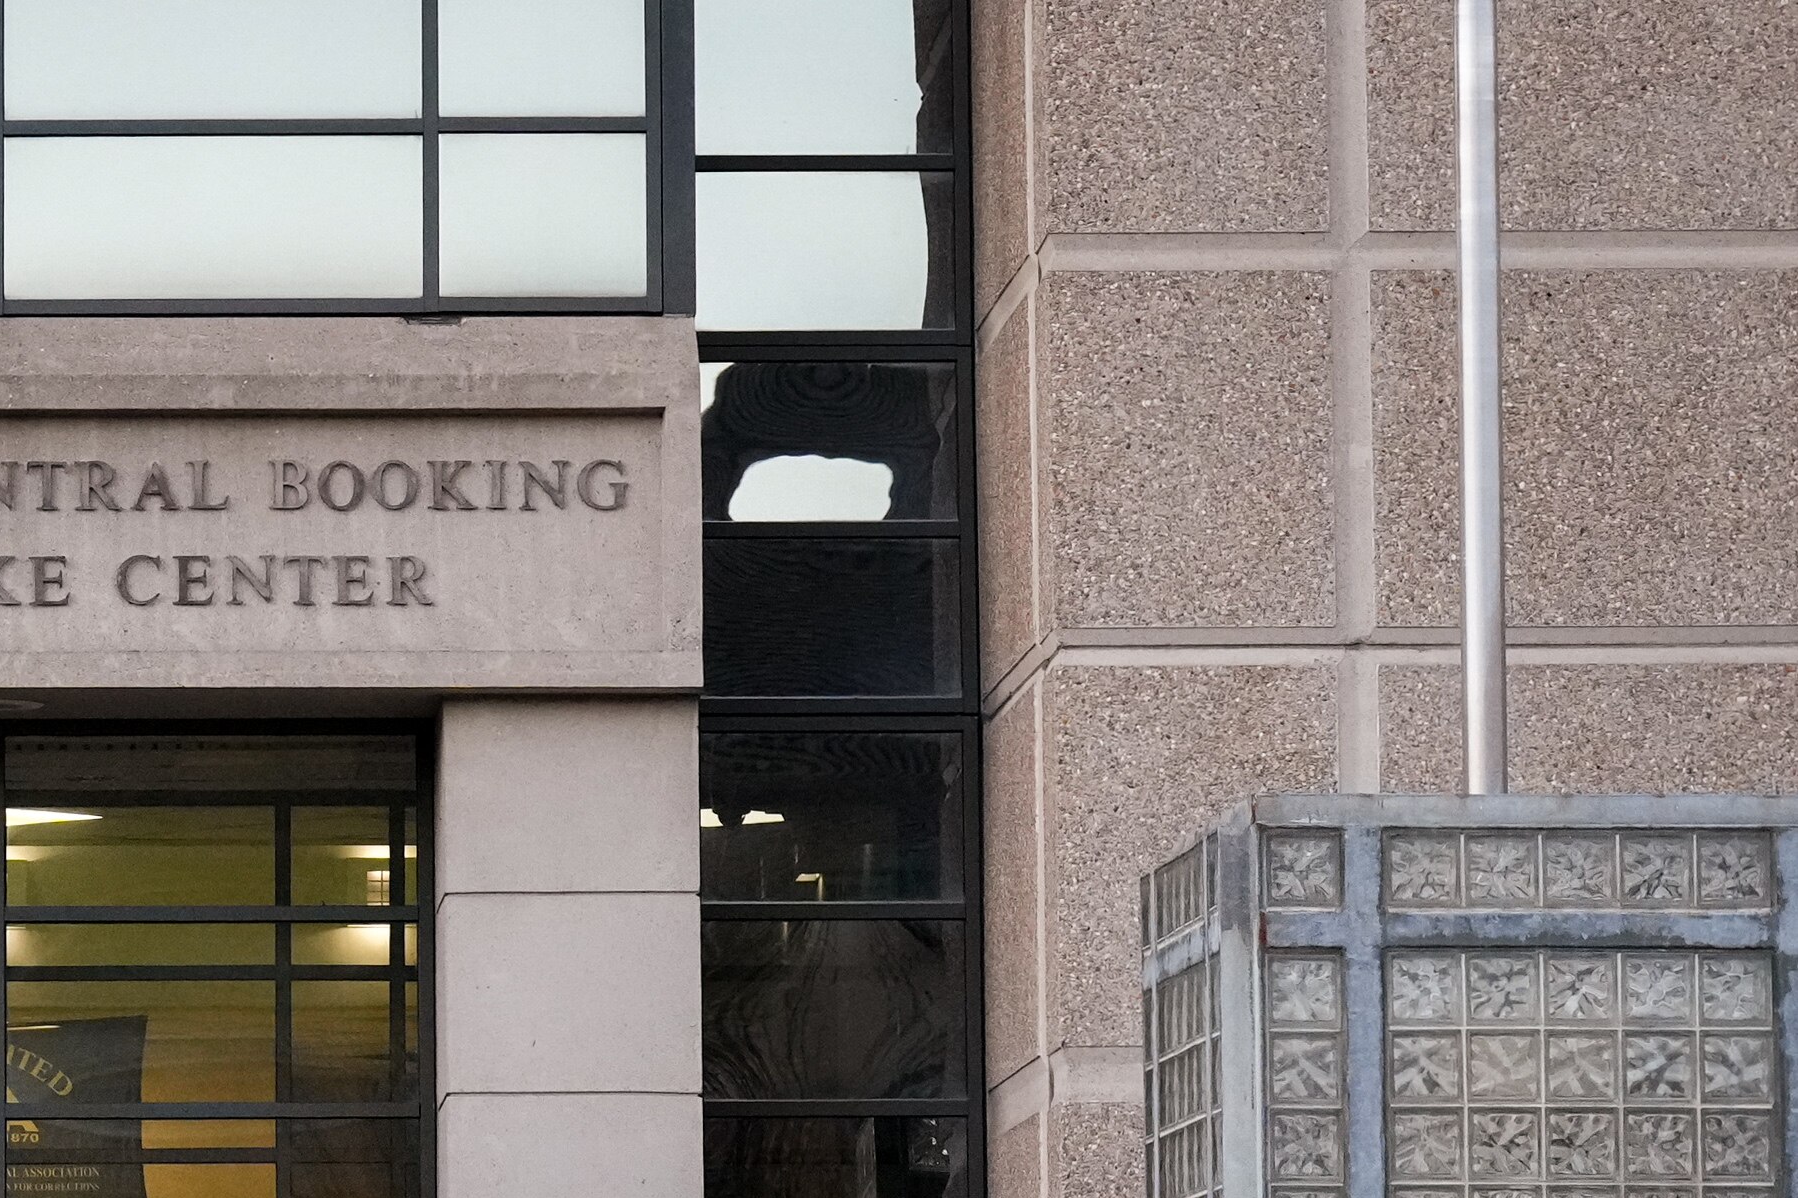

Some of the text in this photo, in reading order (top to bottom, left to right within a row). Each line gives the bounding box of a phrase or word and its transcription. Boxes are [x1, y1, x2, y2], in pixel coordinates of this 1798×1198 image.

[269, 458, 632, 514] BOOKING
[116, 554, 436, 609] CENTER
[14, 1182, 33, 1192] FOR
[23, 1166, 101, 1178] ASSOCIATION
